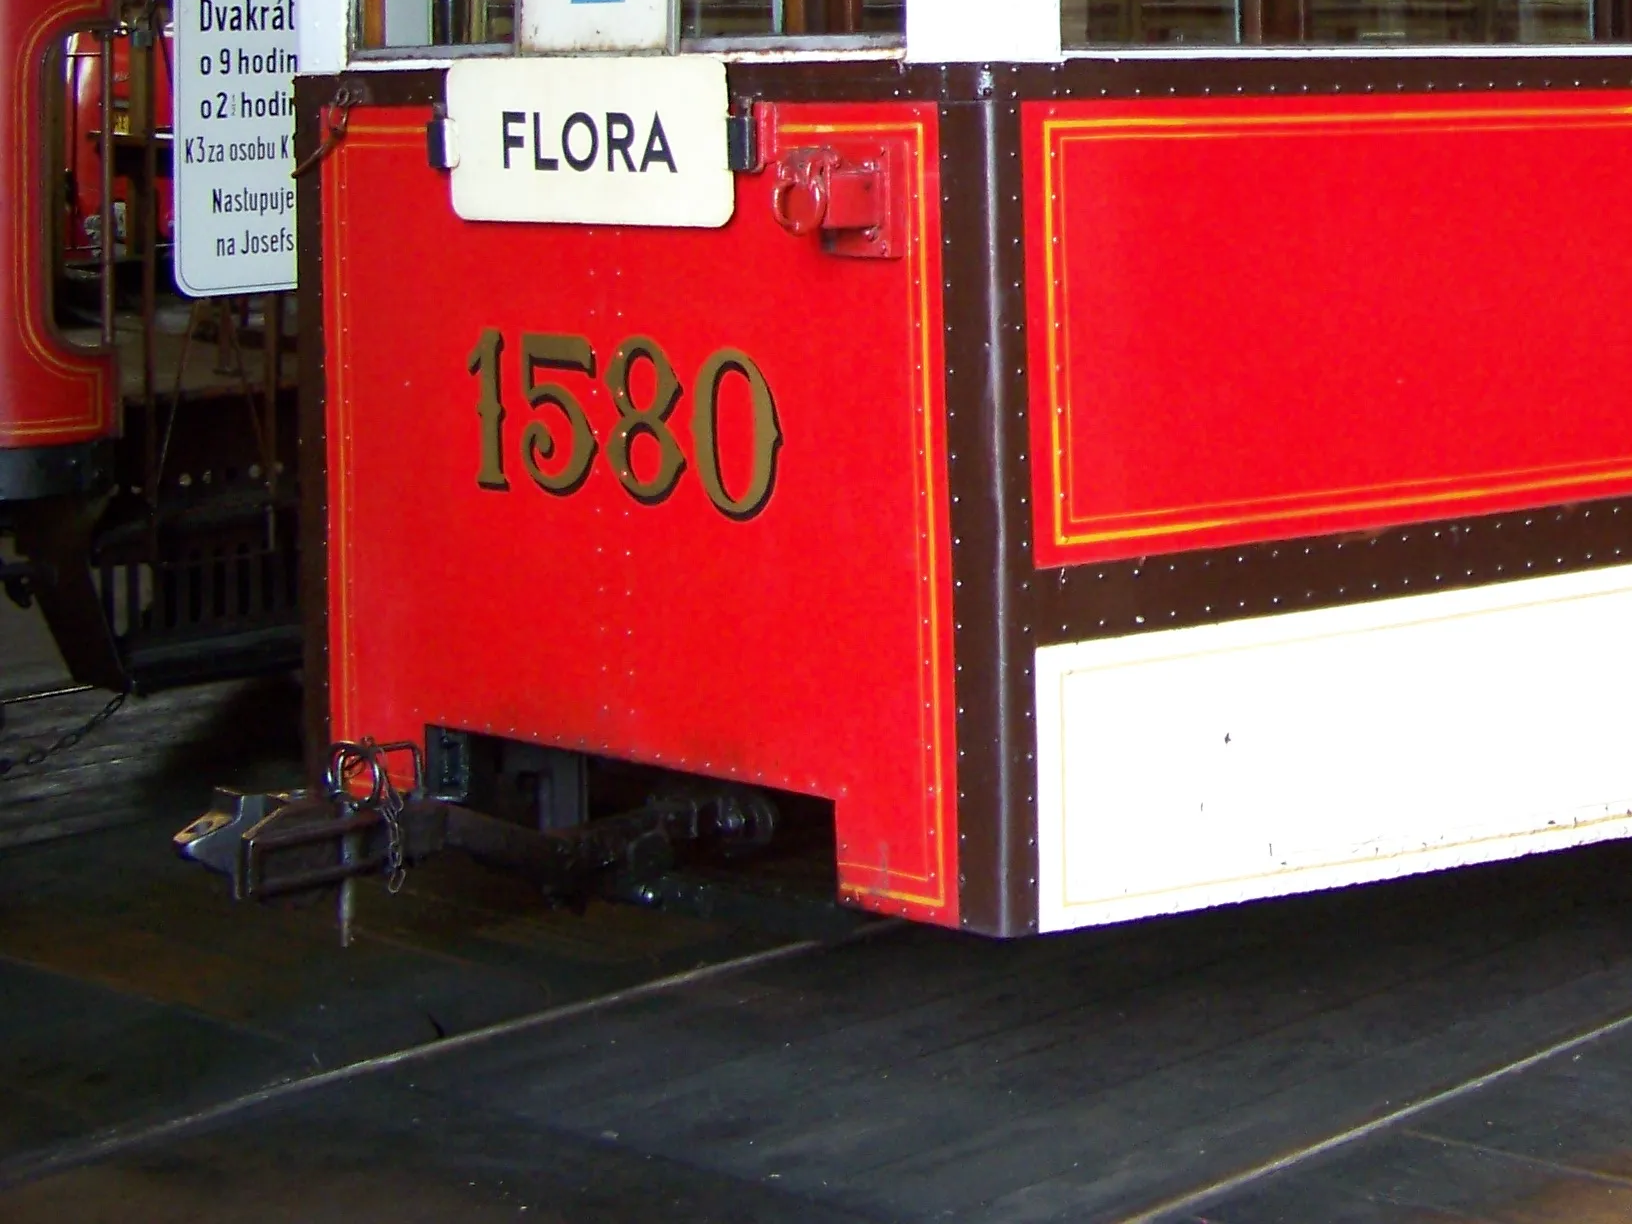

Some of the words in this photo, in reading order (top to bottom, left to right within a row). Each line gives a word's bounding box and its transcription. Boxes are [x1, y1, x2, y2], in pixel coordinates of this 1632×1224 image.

[200, 55, 212, 75] o
[220, 48, 231, 75] 9
[200, 99, 212, 119] o
[229, 135, 275, 161] osobu
[502, 111, 678, 173] FLORA
[216, 238, 236, 256] na
[468, 327, 784, 522] 1580
